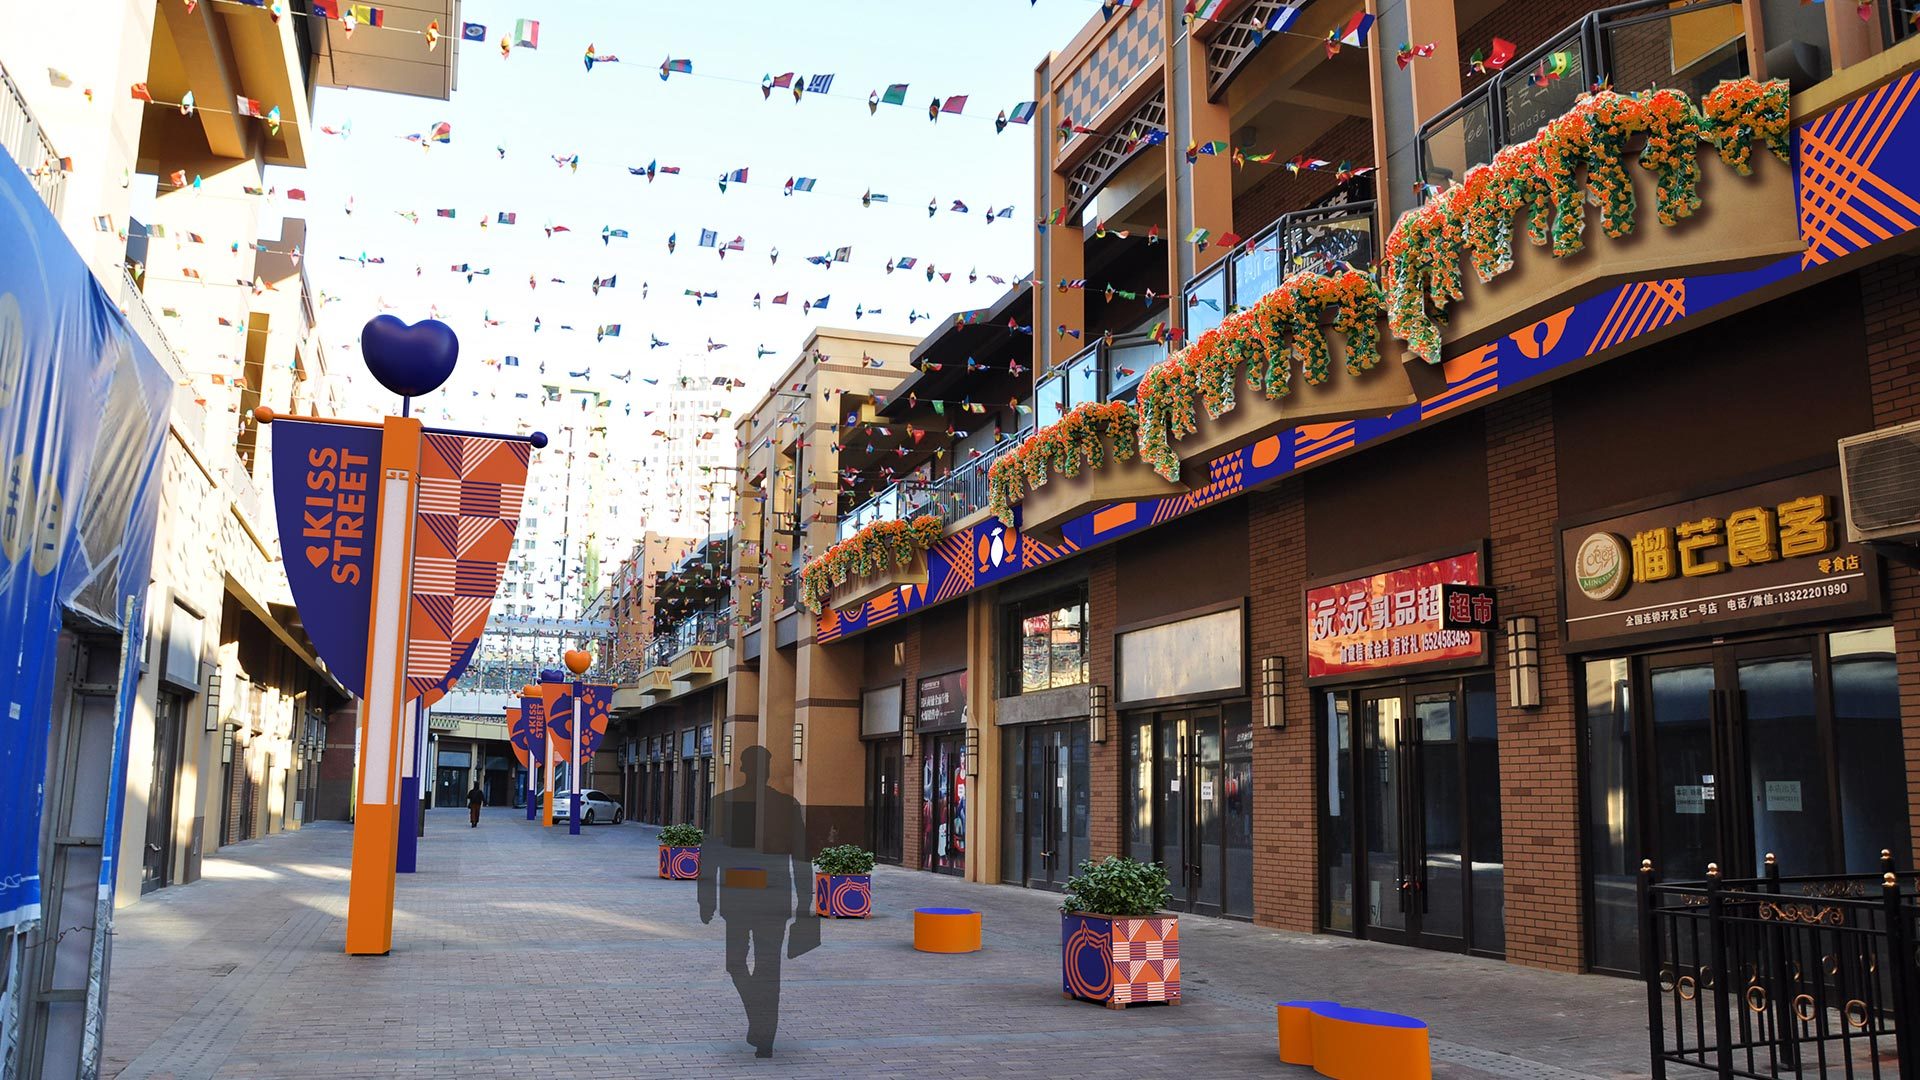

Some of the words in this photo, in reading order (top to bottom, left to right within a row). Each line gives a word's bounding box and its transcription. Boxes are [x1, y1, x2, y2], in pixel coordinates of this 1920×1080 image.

[303, 447, 338, 538] KISS
[331, 448, 369, 586] STREET
[1631, 494, 1833, 583] 榴芒食客
[1818, 555, 1860, 574] 零食店
[1448, 592, 1493, 625] 超市
[1625, 602, 1718, 627] 全国连锁开发区一号店
[529, 703, 537, 727] KISS
[536, 703, 544, 738] STREET
